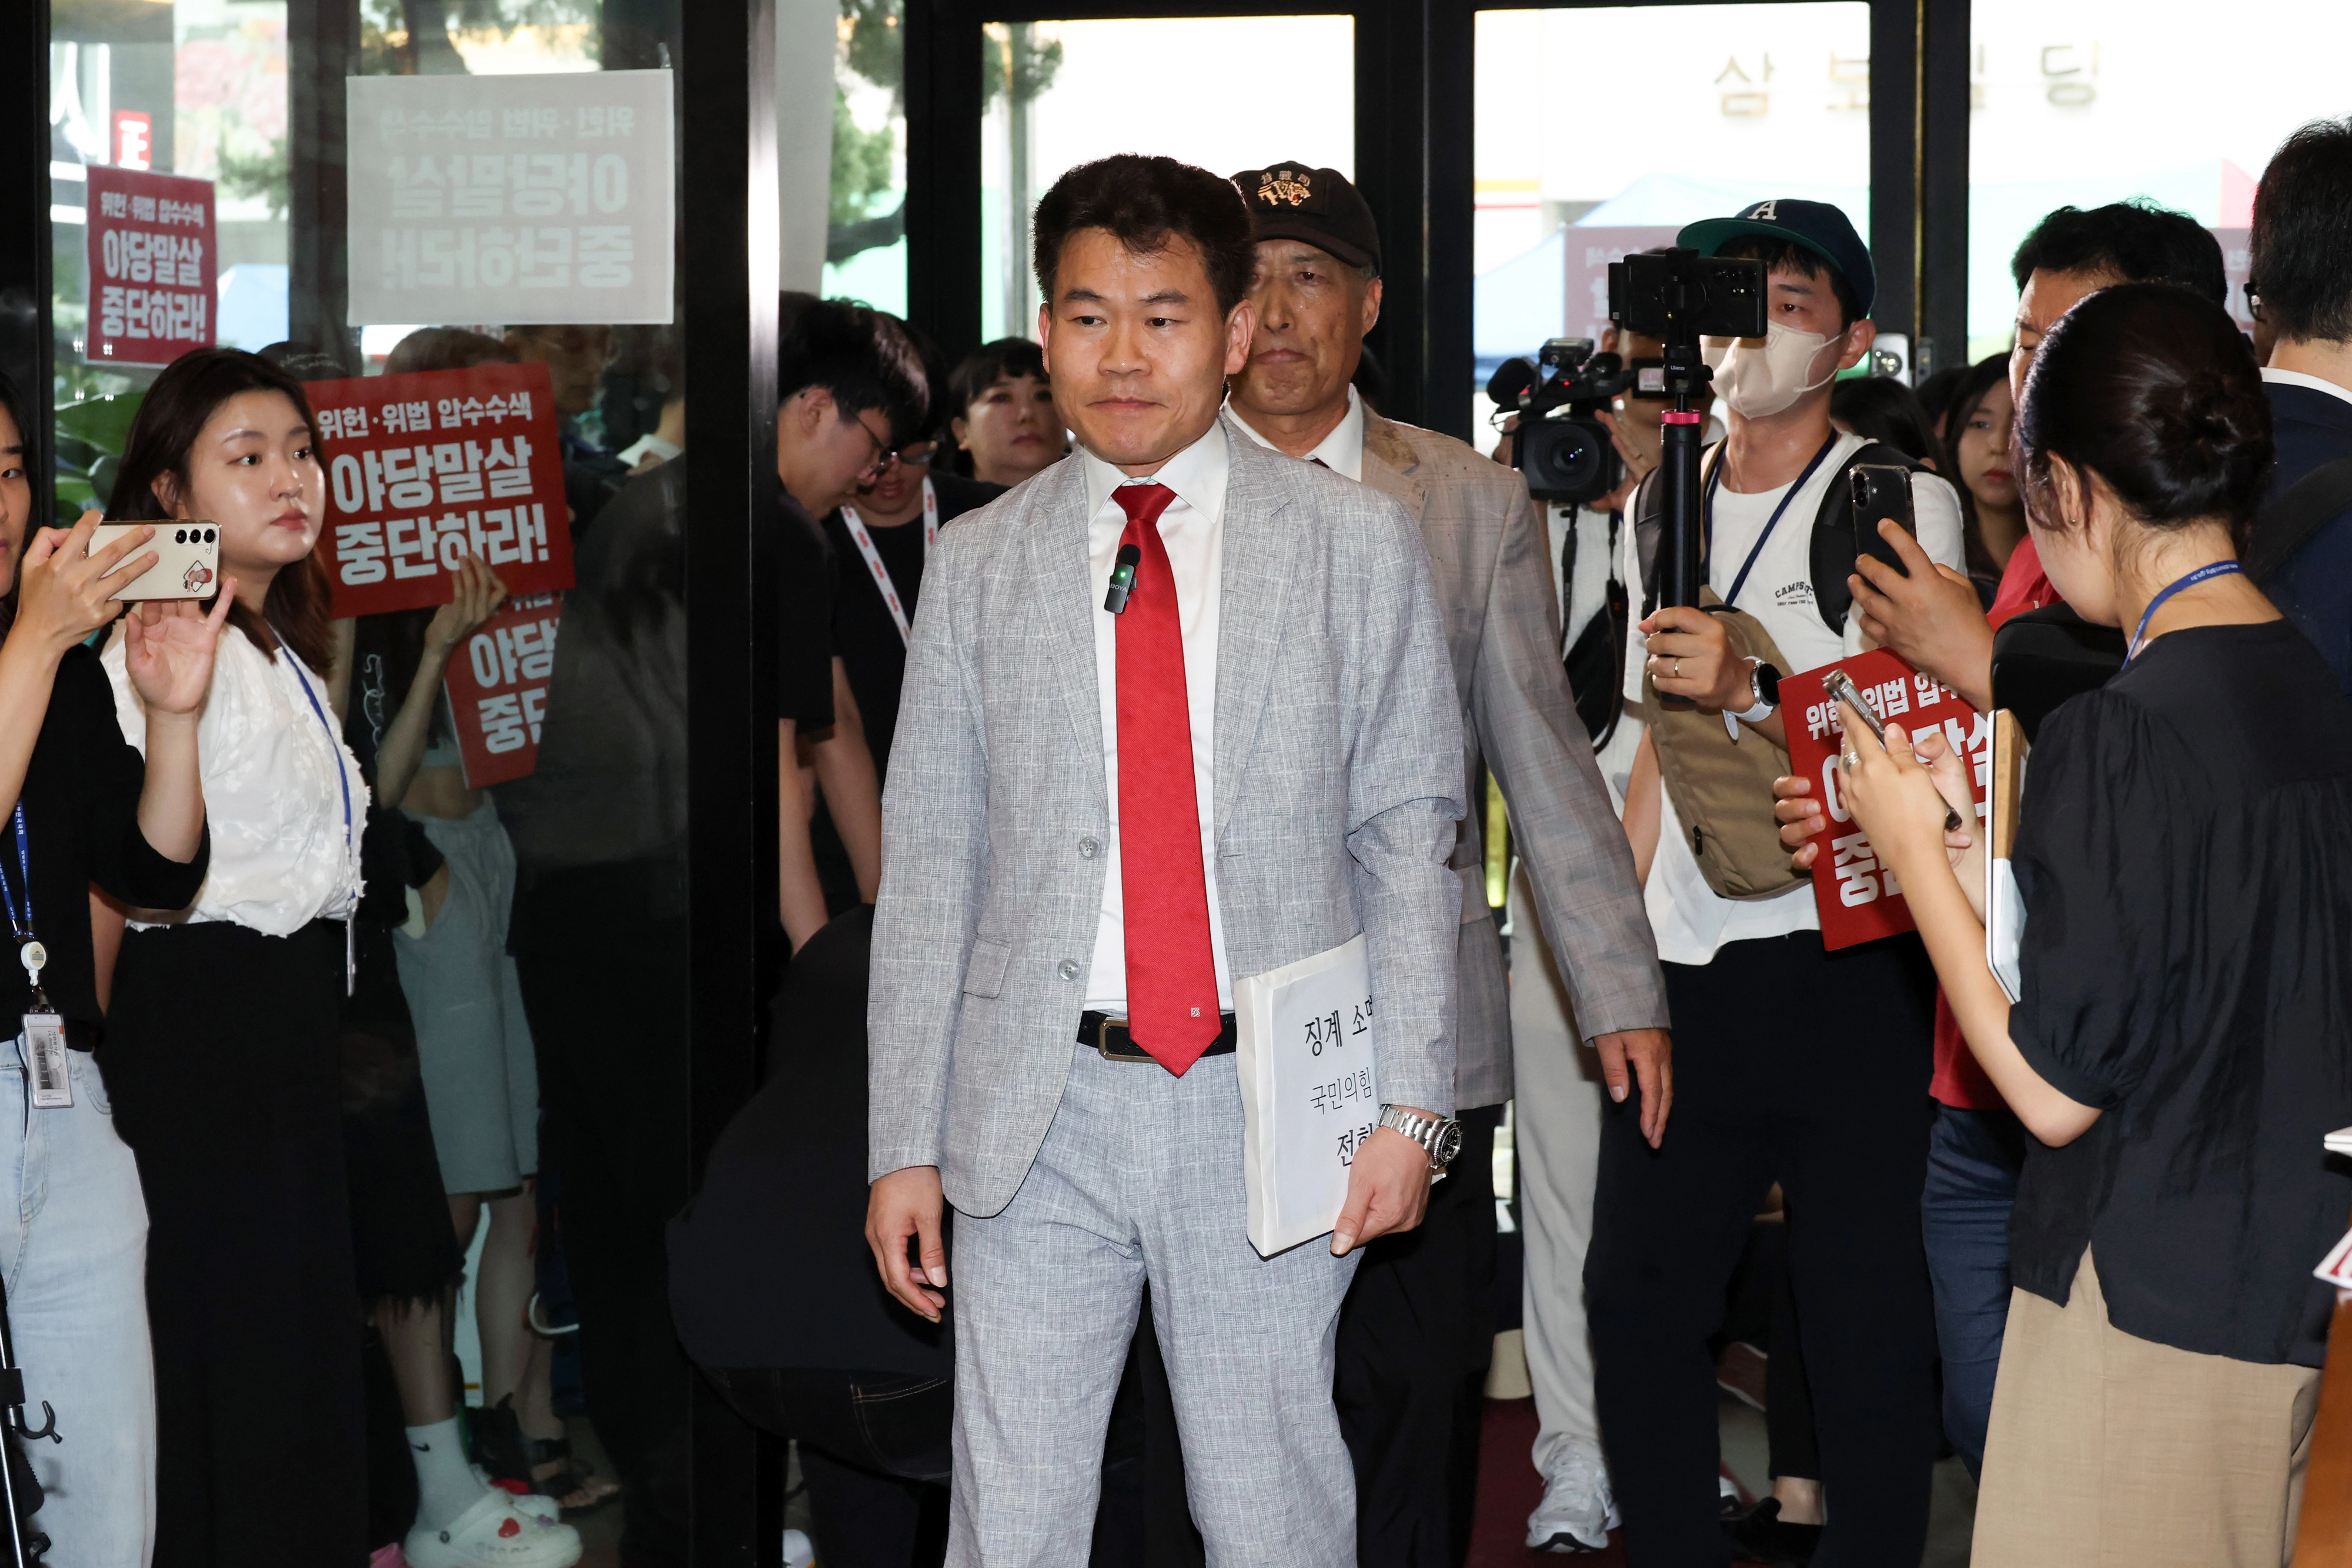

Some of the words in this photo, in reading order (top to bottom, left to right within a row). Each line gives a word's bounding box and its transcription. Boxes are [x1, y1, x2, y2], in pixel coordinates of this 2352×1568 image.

[1747, 200, 1777, 220] A
[102, 229, 202, 287] 야당말살
[101, 286, 206, 342] 중단하라!
[437, 392, 533, 429] 압수수색
[330, 435, 534, 514] 야당말살
[335, 503, 549, 586] 중단하라!
[1110, 583, 1127, 593] BOYA
[1304, 1009, 1342, 1057] 징계
[1310, 1067, 1372, 1115] 국민의힘
